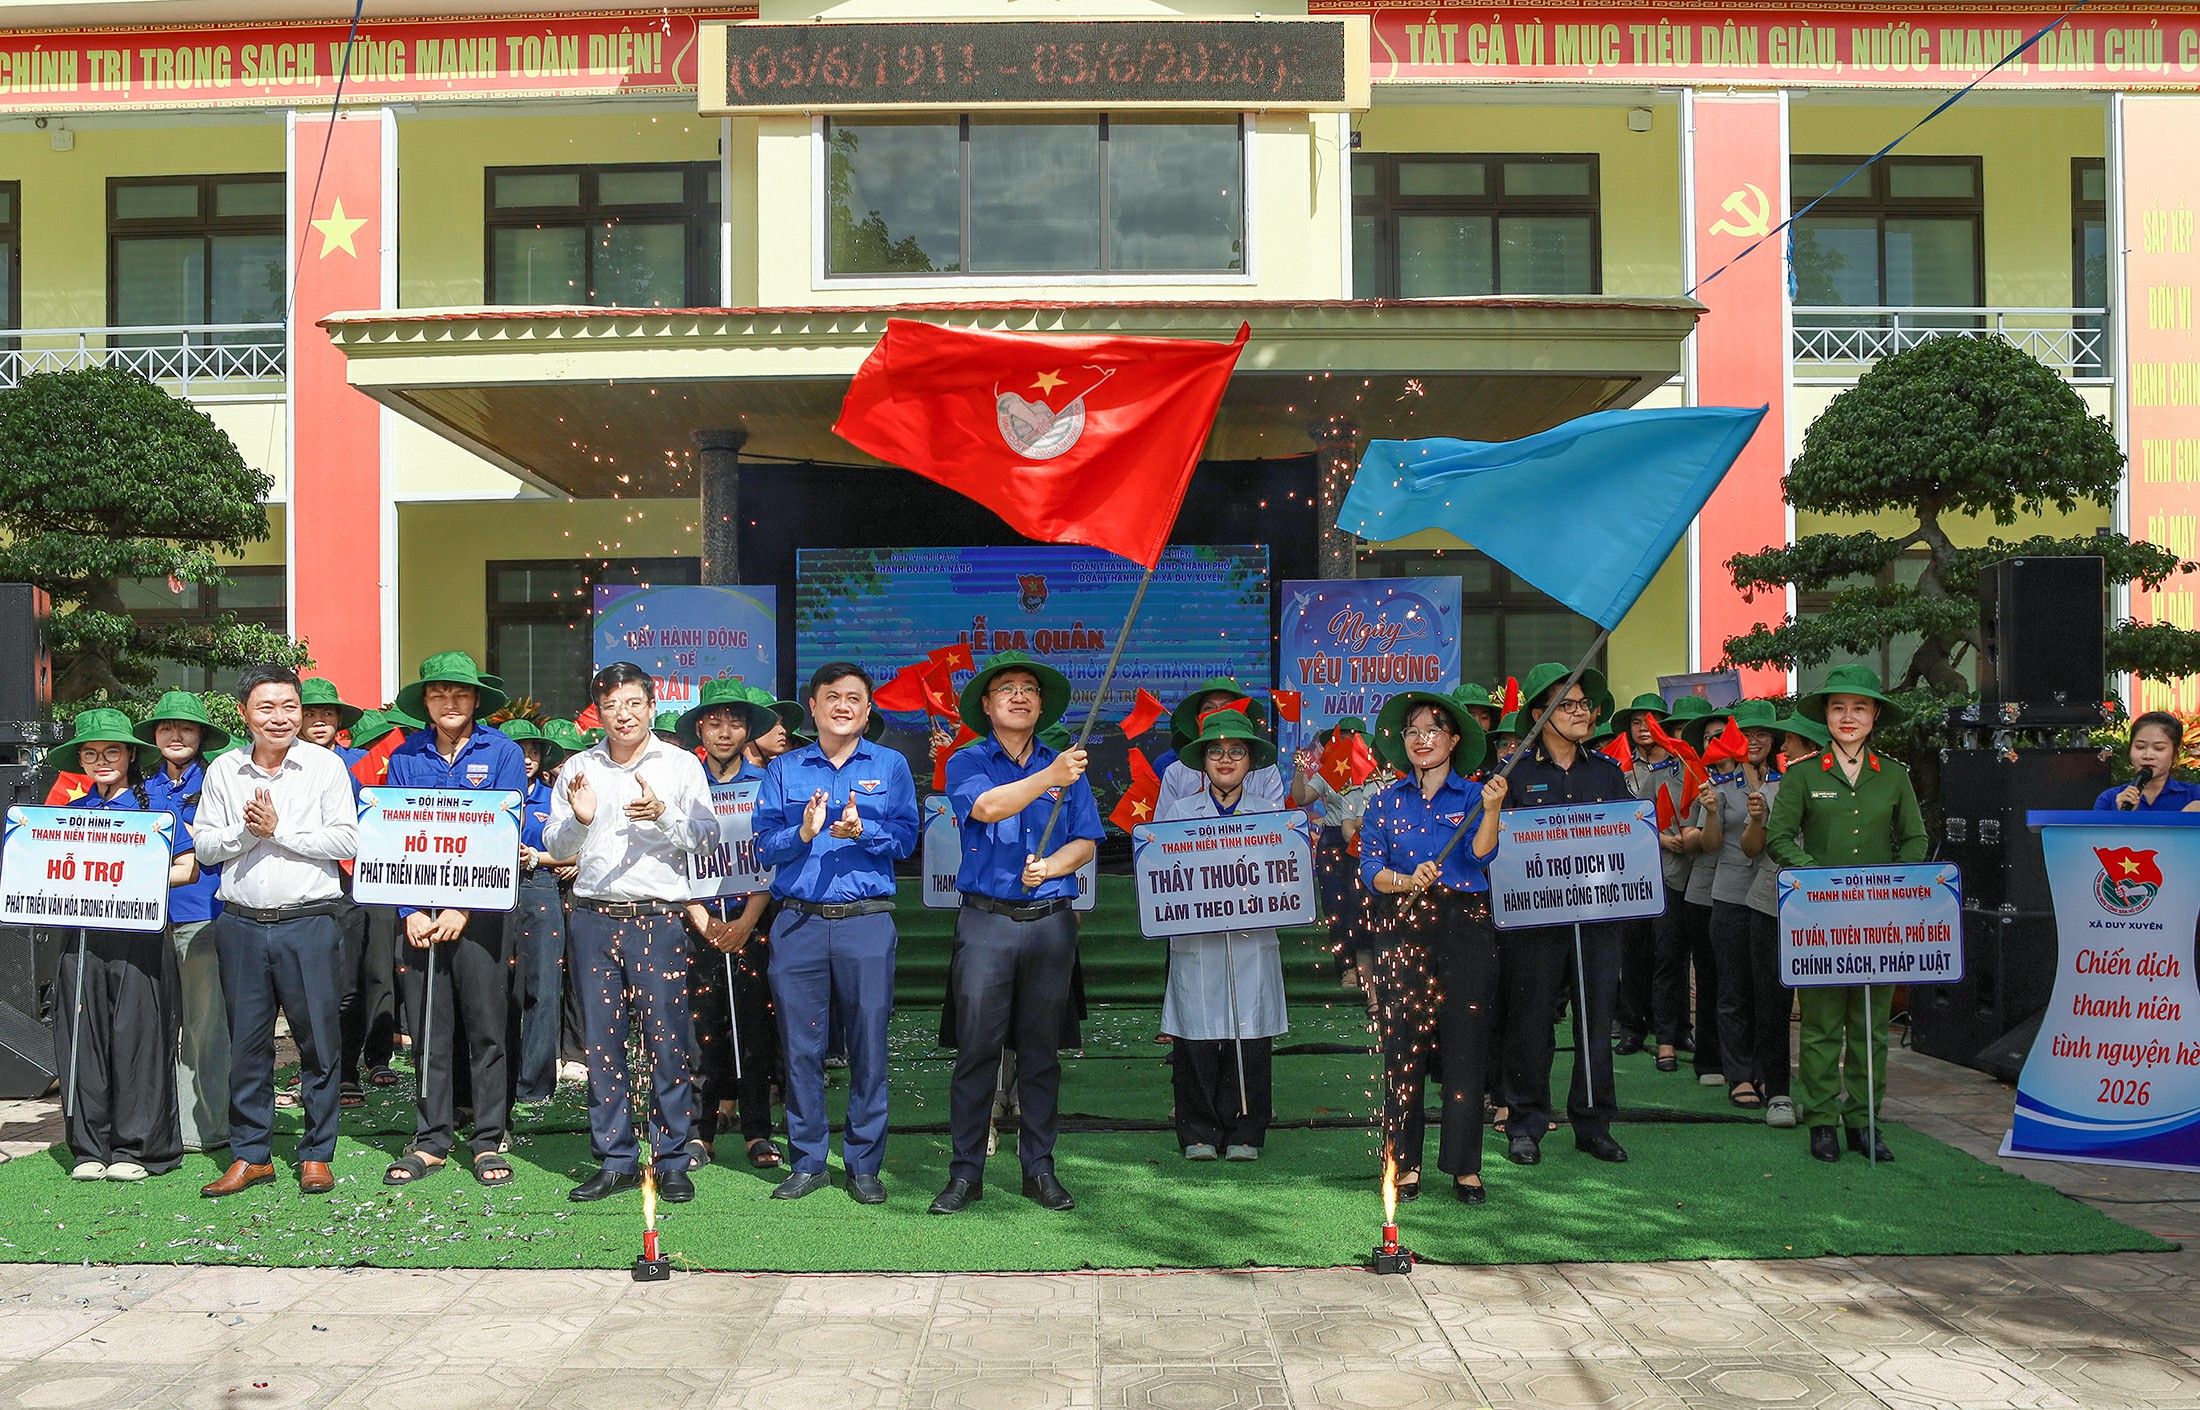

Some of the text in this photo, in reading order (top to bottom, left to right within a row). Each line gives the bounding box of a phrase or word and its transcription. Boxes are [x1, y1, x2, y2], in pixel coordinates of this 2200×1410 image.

[1405, 10, 2170, 81] TẤT CẢ VÌ MỤC TIÊU DÂN GIÀU, NƯỚC MẠNH, DÂN CHỦ,
[0, 26, 663, 99] CHÍNH TRỊ TRONG SẠCH, VỮNG MẠNH TOÀN DIỆN!
[2143, 195, 2194, 254] SẮP XẾP
[2148, 279, 2192, 338] ĐƠN VỊ
[2132, 355, 2200, 407] HÀNH CHÍN
[2142, 438, 2200, 491] TINH GỌN
[2169, 507, 2197, 559] MÁY
[1175, 573, 1192, 582] DUY
[627, 626, 749, 650] HÃY HÀNH ĐỘNG
[958, 615, 1105, 654] LỄ RA QUÂN
[1328, 610, 1404, 652] Ngày
[678, 649, 697, 667] ĐỂ
[1154, 661, 1200, 679] THÀNH
[1205, 657, 1235, 678] PHỐ
[1298, 651, 1441, 685] YÊU THƯƠNG
[652, 670, 690, 701] RÁI
[1324, 691, 1365, 715] NĂM
[418, 794, 460, 809] ĐỘI HÌNH
[712, 790, 736, 801] HÌNH
[713, 803, 735, 815] TÌNH
[69, 814, 111, 829] ĐỘI HÌNH
[382, 808, 495, 826] THANH NIÊN TÌNH NGUYỆN
[1198, 822, 1243, 838] ĐỘI HÌNH
[1549, 812, 1592, 826] ĐỘI HÌNH
[31, 828, 146, 847] THANH NIÊN TÌNH NGUYỆN
[405, 830, 468, 857] HỖ TRỢ
[1162, 831, 1283, 854] THANH NIÊN TÌNH NGUYỆN
[1513, 822, 1631, 843] THANH NIÊN TÌNH NGUYỆN
[47, 852, 125, 887] HỖ TRỢ
[360, 855, 510, 892] PHÁT TRIỂN KINH TẾ ĐỊA PHƯƠNG
[736, 839, 772, 882] HỌ
[1148, 850, 1299, 894] THẦY THUỐC TRẺ
[1525, 852, 1625, 880] HỖ TRỢ DỊCH VỤ
[1503, 876, 1653, 912] HÀNH CHÍNH CÔNG TRỰC TUYẾN
[1807, 885, 1932, 902] THANH NIÊN TÌNH NGUYỆN
[1845, 873, 1891, 887] ĐỘI HÌNH
[5, 889, 160, 921] PHÁT TRIỂN VĂN HÓA TRONG KỶ NGUYÊN MỚI
[1155, 892, 1301, 922] LÀM THEO LỜI BÁC
[1791, 918, 1951, 948] TƯ VẤN, TUYÊN TRUYỀN, PHỔ BIẾN
[2089, 920, 2103, 928] XÃ
[2128, 921, 2163, 930] XUYÊN
[1792, 950, 1952, 976] CHÍNH SÁCH, PHÁP LUẬT
[2075, 947, 2180, 982] Chiến dịch
[2073, 994, 2181, 1021] thanh niên
[2052, 1035, 2200, 1068] tình nguyện hè
[2097, 1077, 2151, 1106] 2026
